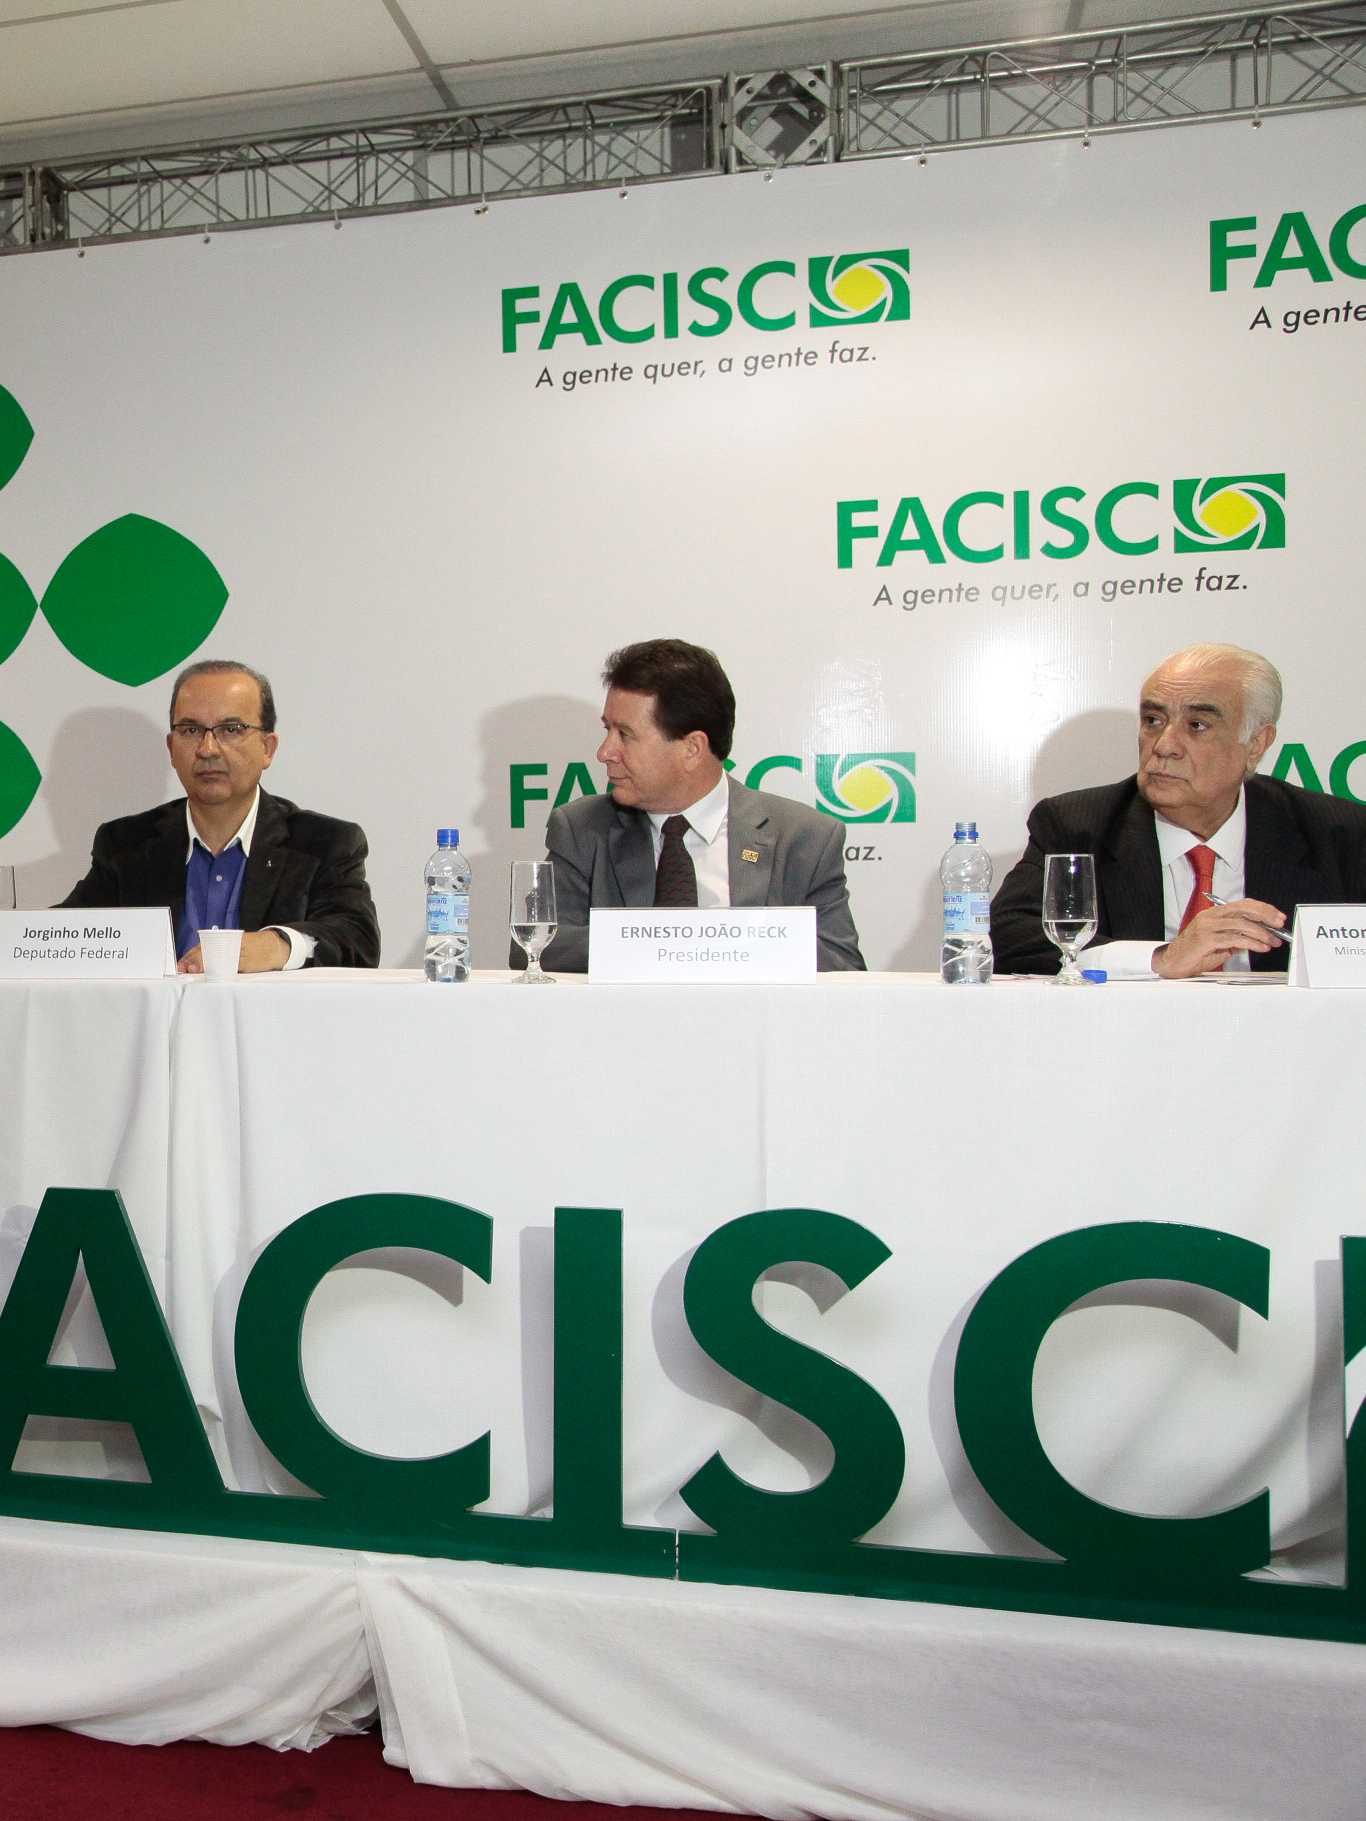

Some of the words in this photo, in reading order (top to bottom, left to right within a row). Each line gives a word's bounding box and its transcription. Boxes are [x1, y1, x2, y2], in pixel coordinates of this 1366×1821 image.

[501, 260, 797, 353] FACISC
[1248, 306, 1272, 330] A
[535, 367, 554, 388] A
[562, 362, 633, 391] gente
[643, 359, 706, 384] quer,
[718, 355, 733, 373] a
[744, 347, 818, 376] gente
[829, 340, 877, 364] faz.
[836, 482, 1160, 569] FACISC
[873, 584, 893, 607] A
[902, 582, 979, 611] gente
[991, 580, 1060, 607] quer,
[1072, 581, 1089, 598] a
[1101, 572, 1184, 602] gente
[1195, 566, 1248, 592] faz.
[23, 927, 79, 941] Jorginho
[83, 927, 121, 939] Mello
[621, 926, 693, 939] ERNESTO
[697, 923, 742, 939] JOÃO
[747, 926, 787, 939] RECK
[14, 947, 76, 960] Deputado
[80, 947, 129, 959] Federal
[657, 948, 750, 962] Presidente
